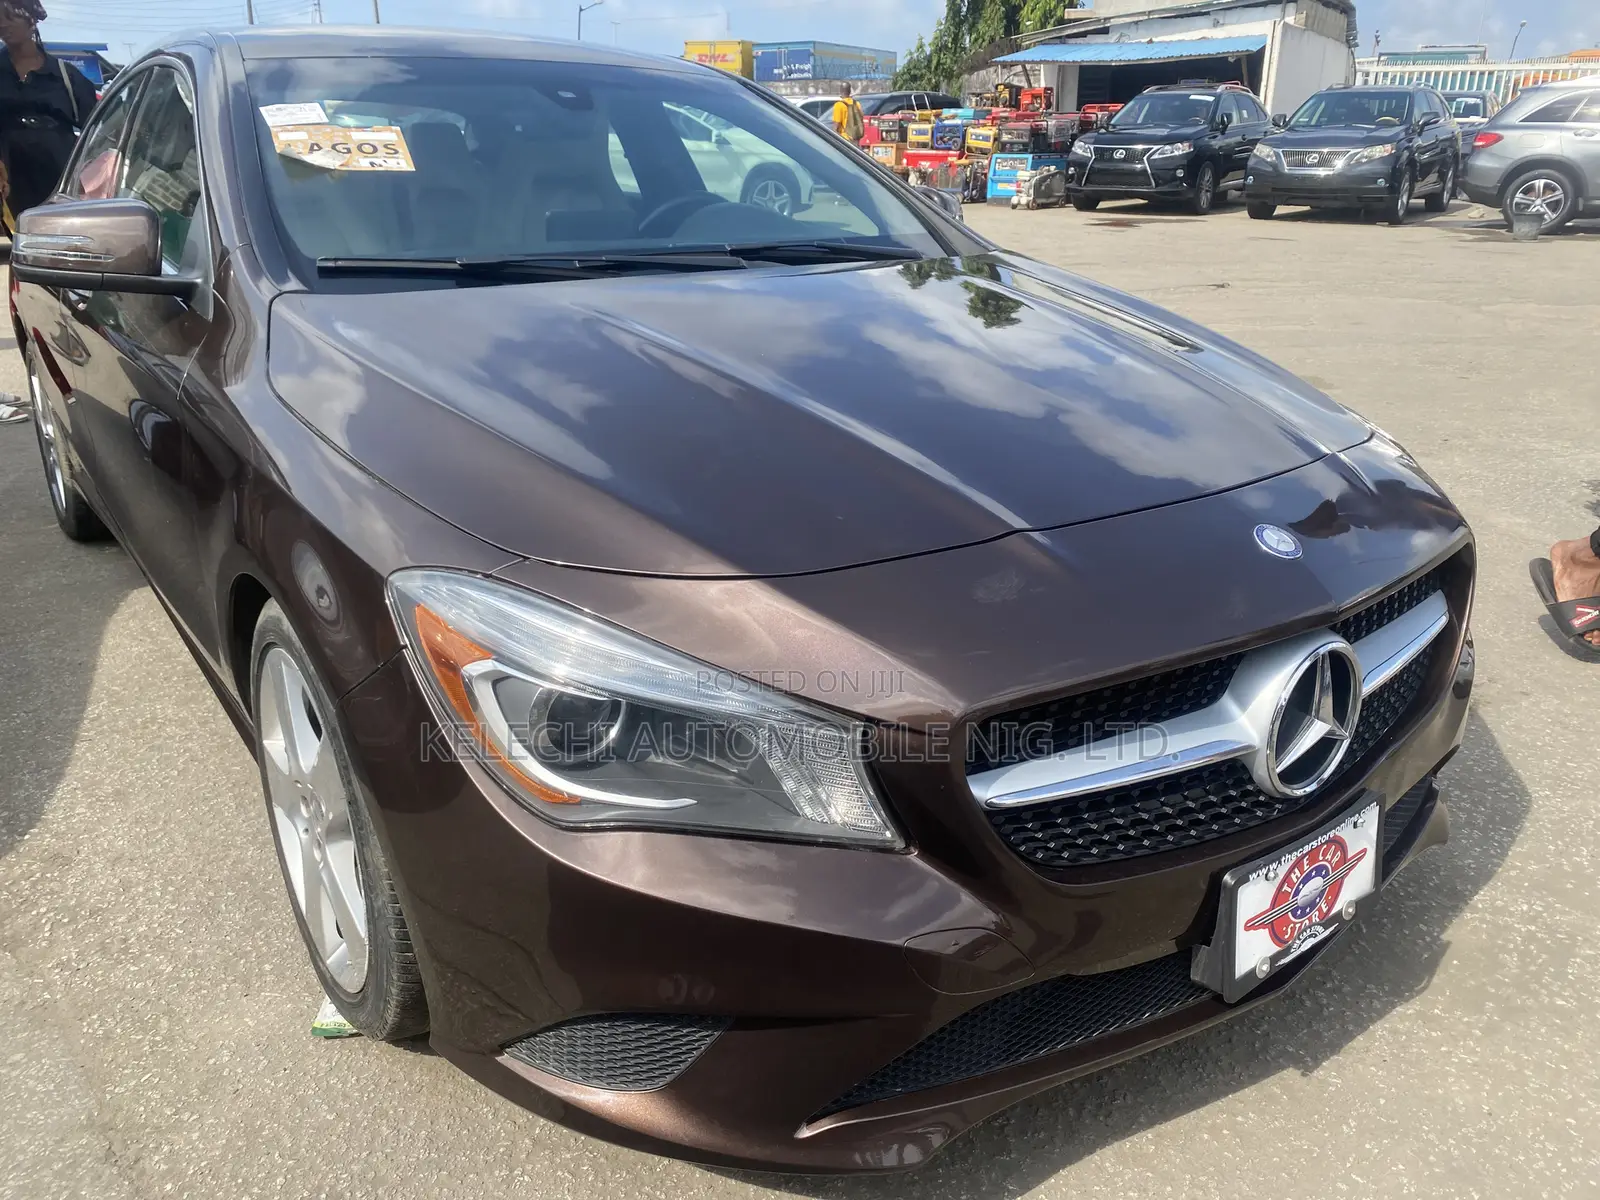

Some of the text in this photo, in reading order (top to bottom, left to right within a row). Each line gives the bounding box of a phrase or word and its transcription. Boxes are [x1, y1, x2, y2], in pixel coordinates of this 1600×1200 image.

[286, 142, 400, 155] AGOS
[1248, 801, 1378, 882] www.thecarstoreonline.com
[1282, 844, 1341, 893] THE CAR
[1284, 899, 1329, 939] STORE
